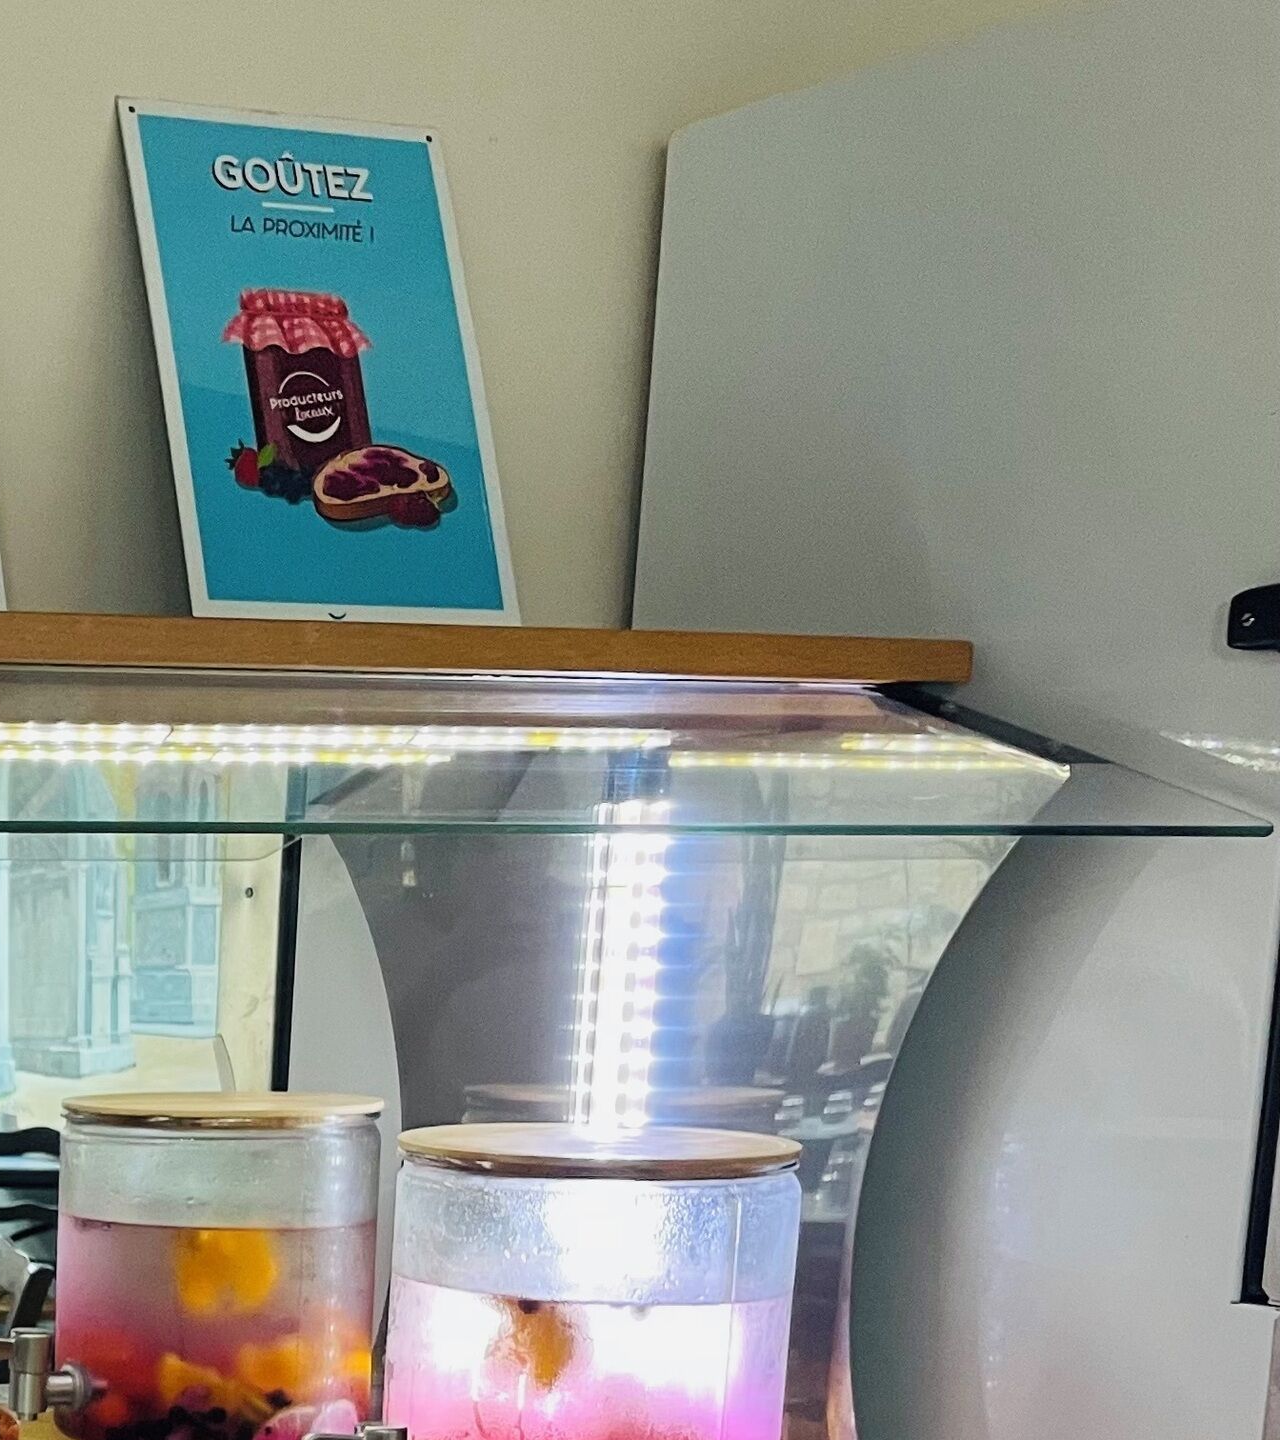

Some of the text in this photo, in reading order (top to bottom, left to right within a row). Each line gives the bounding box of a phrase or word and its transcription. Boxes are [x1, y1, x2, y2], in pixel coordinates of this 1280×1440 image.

[212, 150, 374, 202] GOÛTEZ
[230, 214, 363, 243] LA PROXIMITÉ
[269, 388, 344, 411] Producteurs
